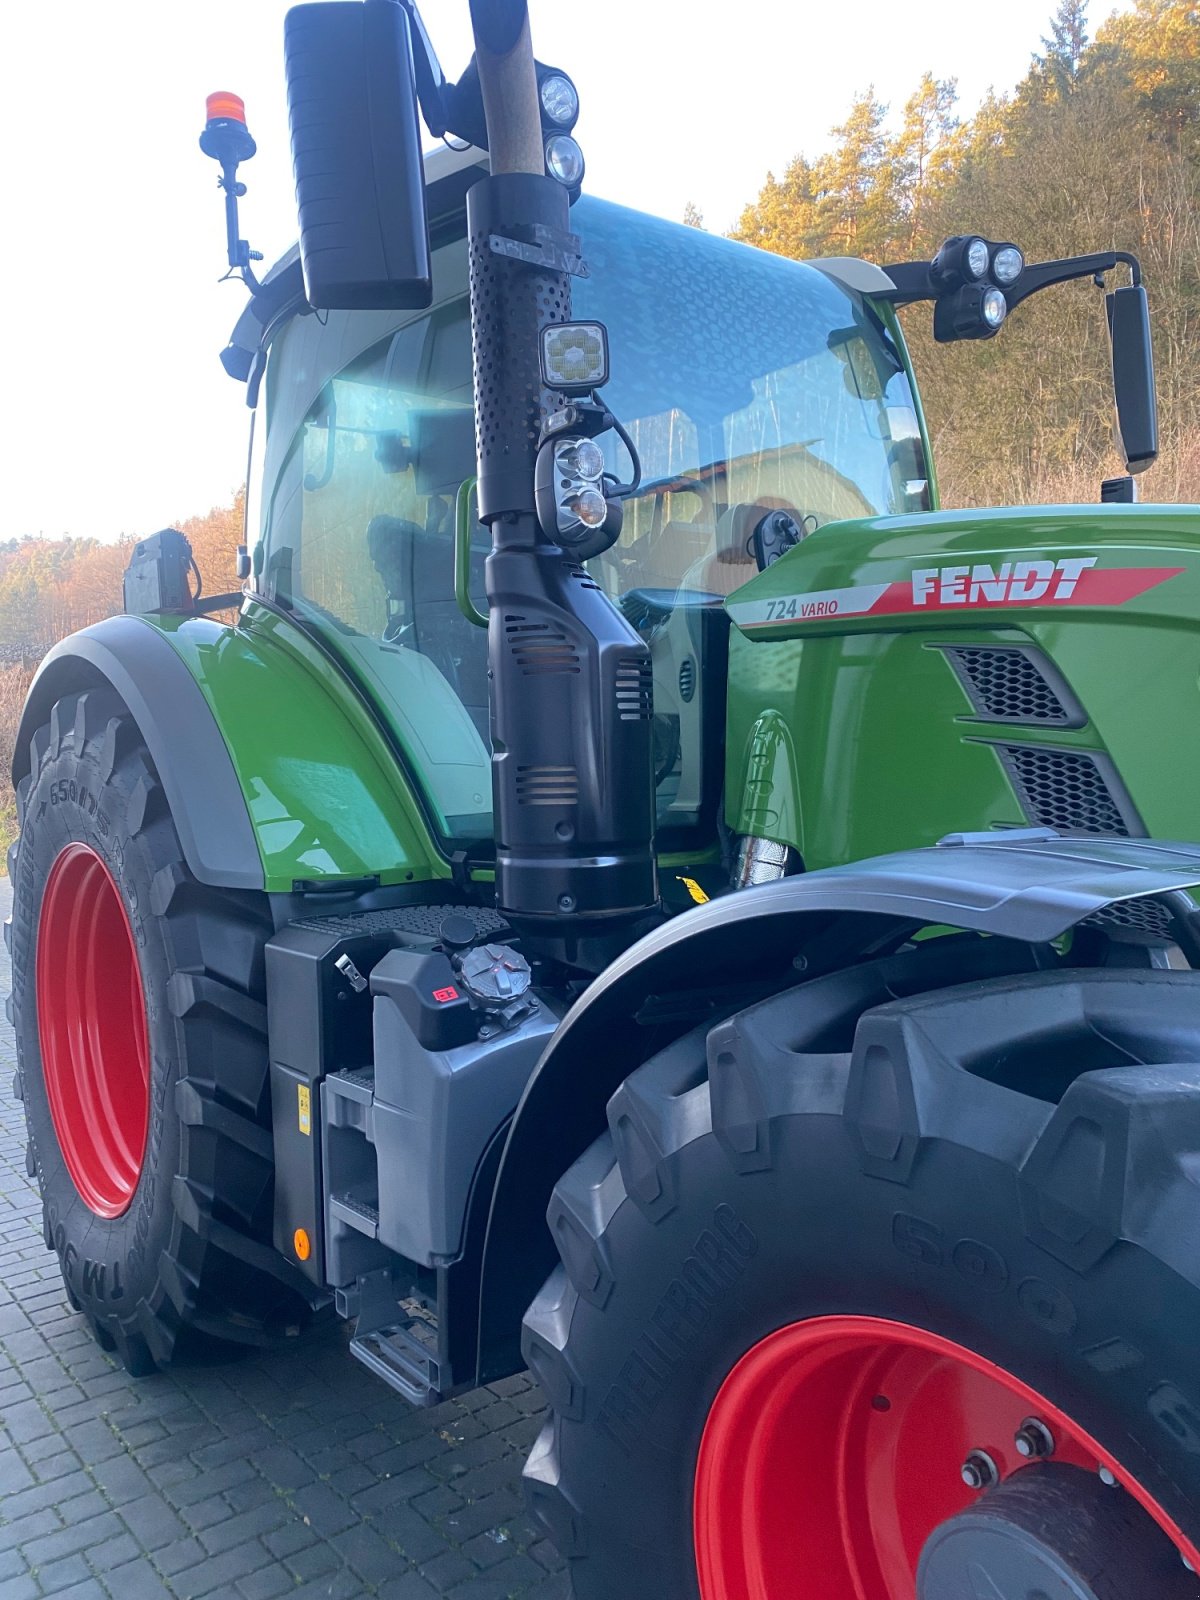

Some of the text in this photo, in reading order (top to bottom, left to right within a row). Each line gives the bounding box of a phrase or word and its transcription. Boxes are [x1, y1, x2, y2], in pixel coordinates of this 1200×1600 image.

[911, 557, 1098, 605] FENDT
[766, 598, 838, 621] 724 VARIO
